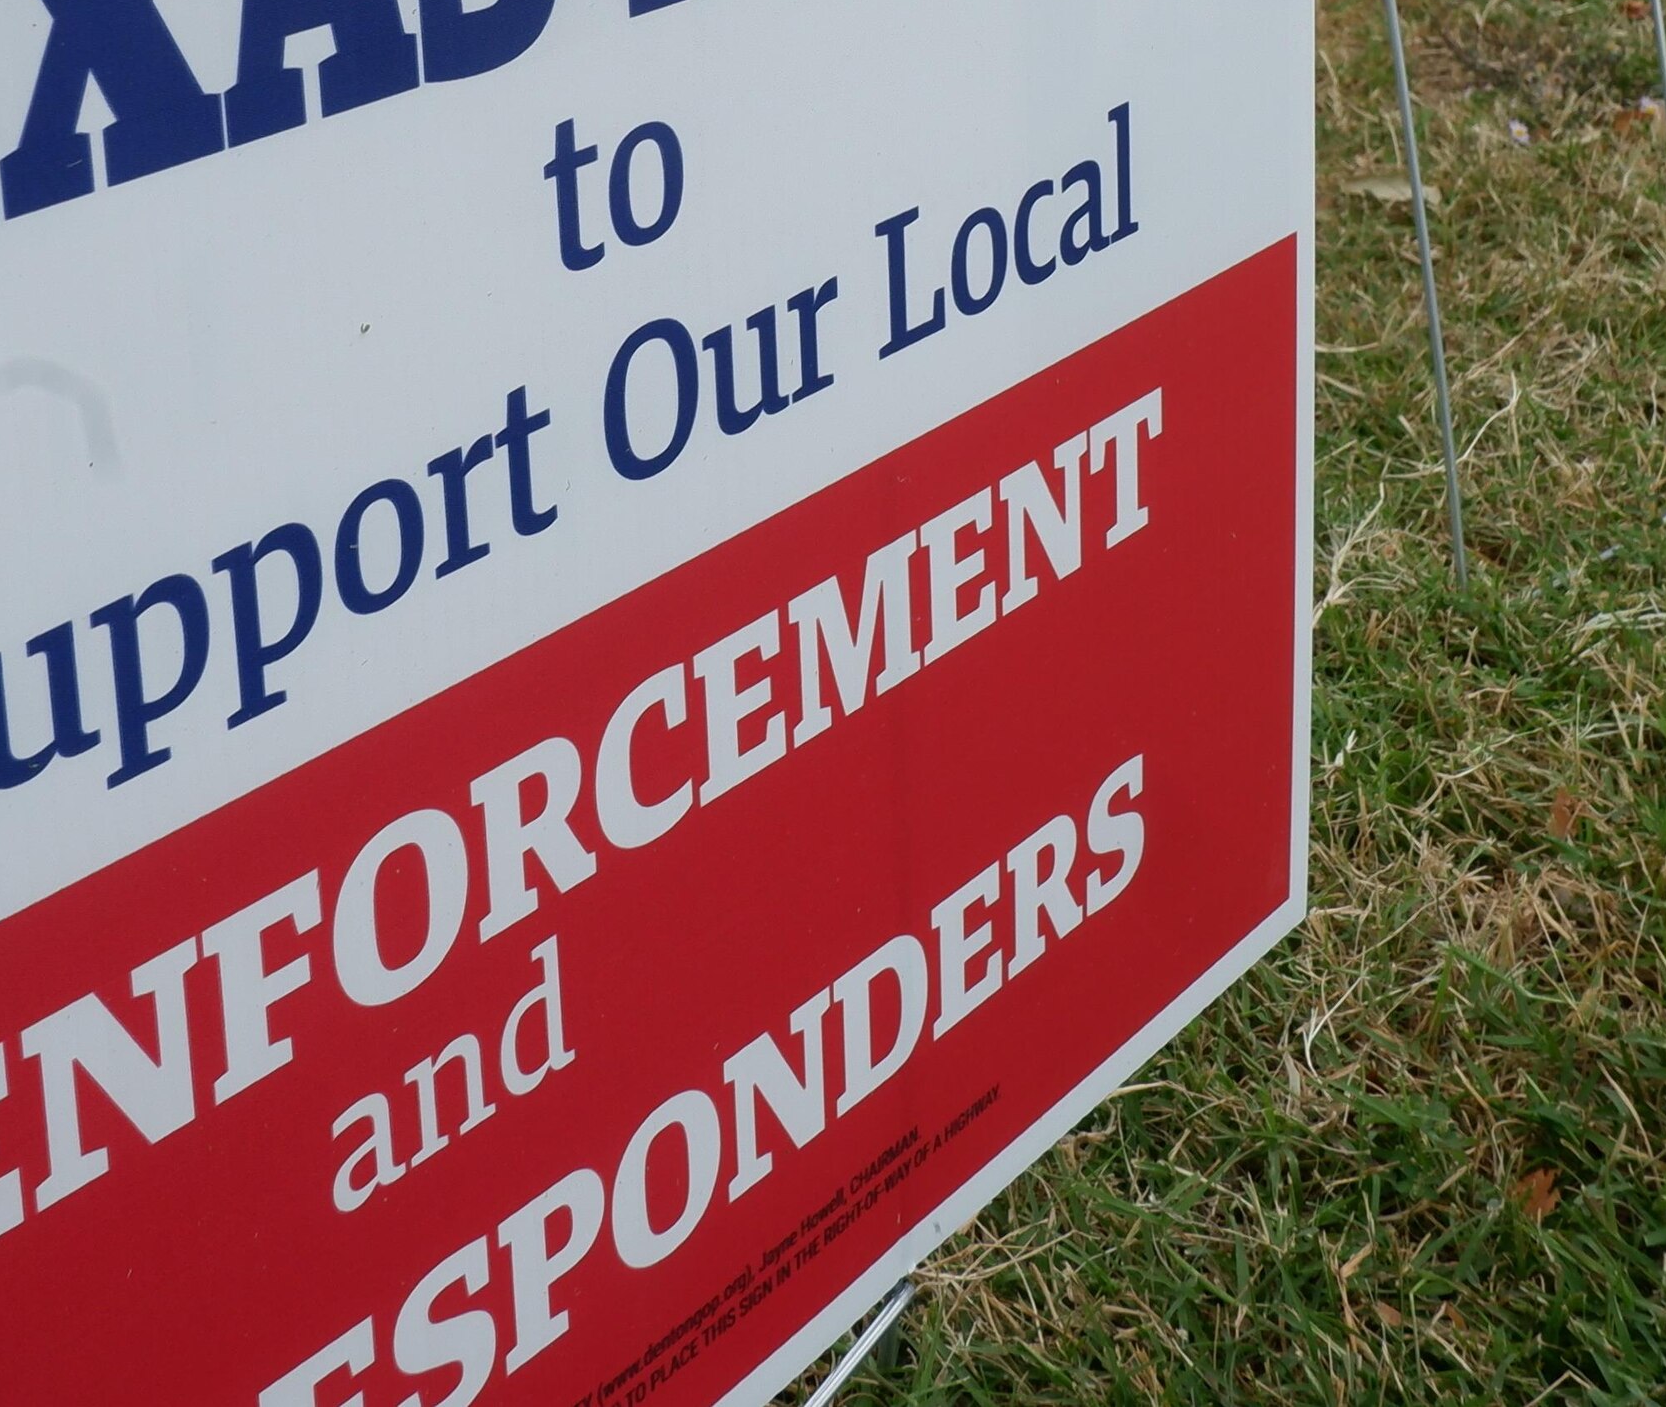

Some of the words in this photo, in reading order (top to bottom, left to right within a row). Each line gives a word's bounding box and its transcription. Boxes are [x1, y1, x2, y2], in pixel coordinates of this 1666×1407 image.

[544, 119, 683, 270] to
[604, 277, 838, 480] Our
[876, 102, 1138, 359] Local
[333, 935, 575, 1212] and
[650, 1337, 699, 1393] PLACE
[701, 1306, 737, 1349] THIS
[739, 1274, 774, 1318] SIGN
[776, 1260, 792, 1286] IN
[794, 1237, 823, 1271] THE
[823, 1161, 913, 1246] RIGHT-OF-WAY
[913, 1142, 931, 1168] OF
[759, 1229, 798, 1272] Jayne
